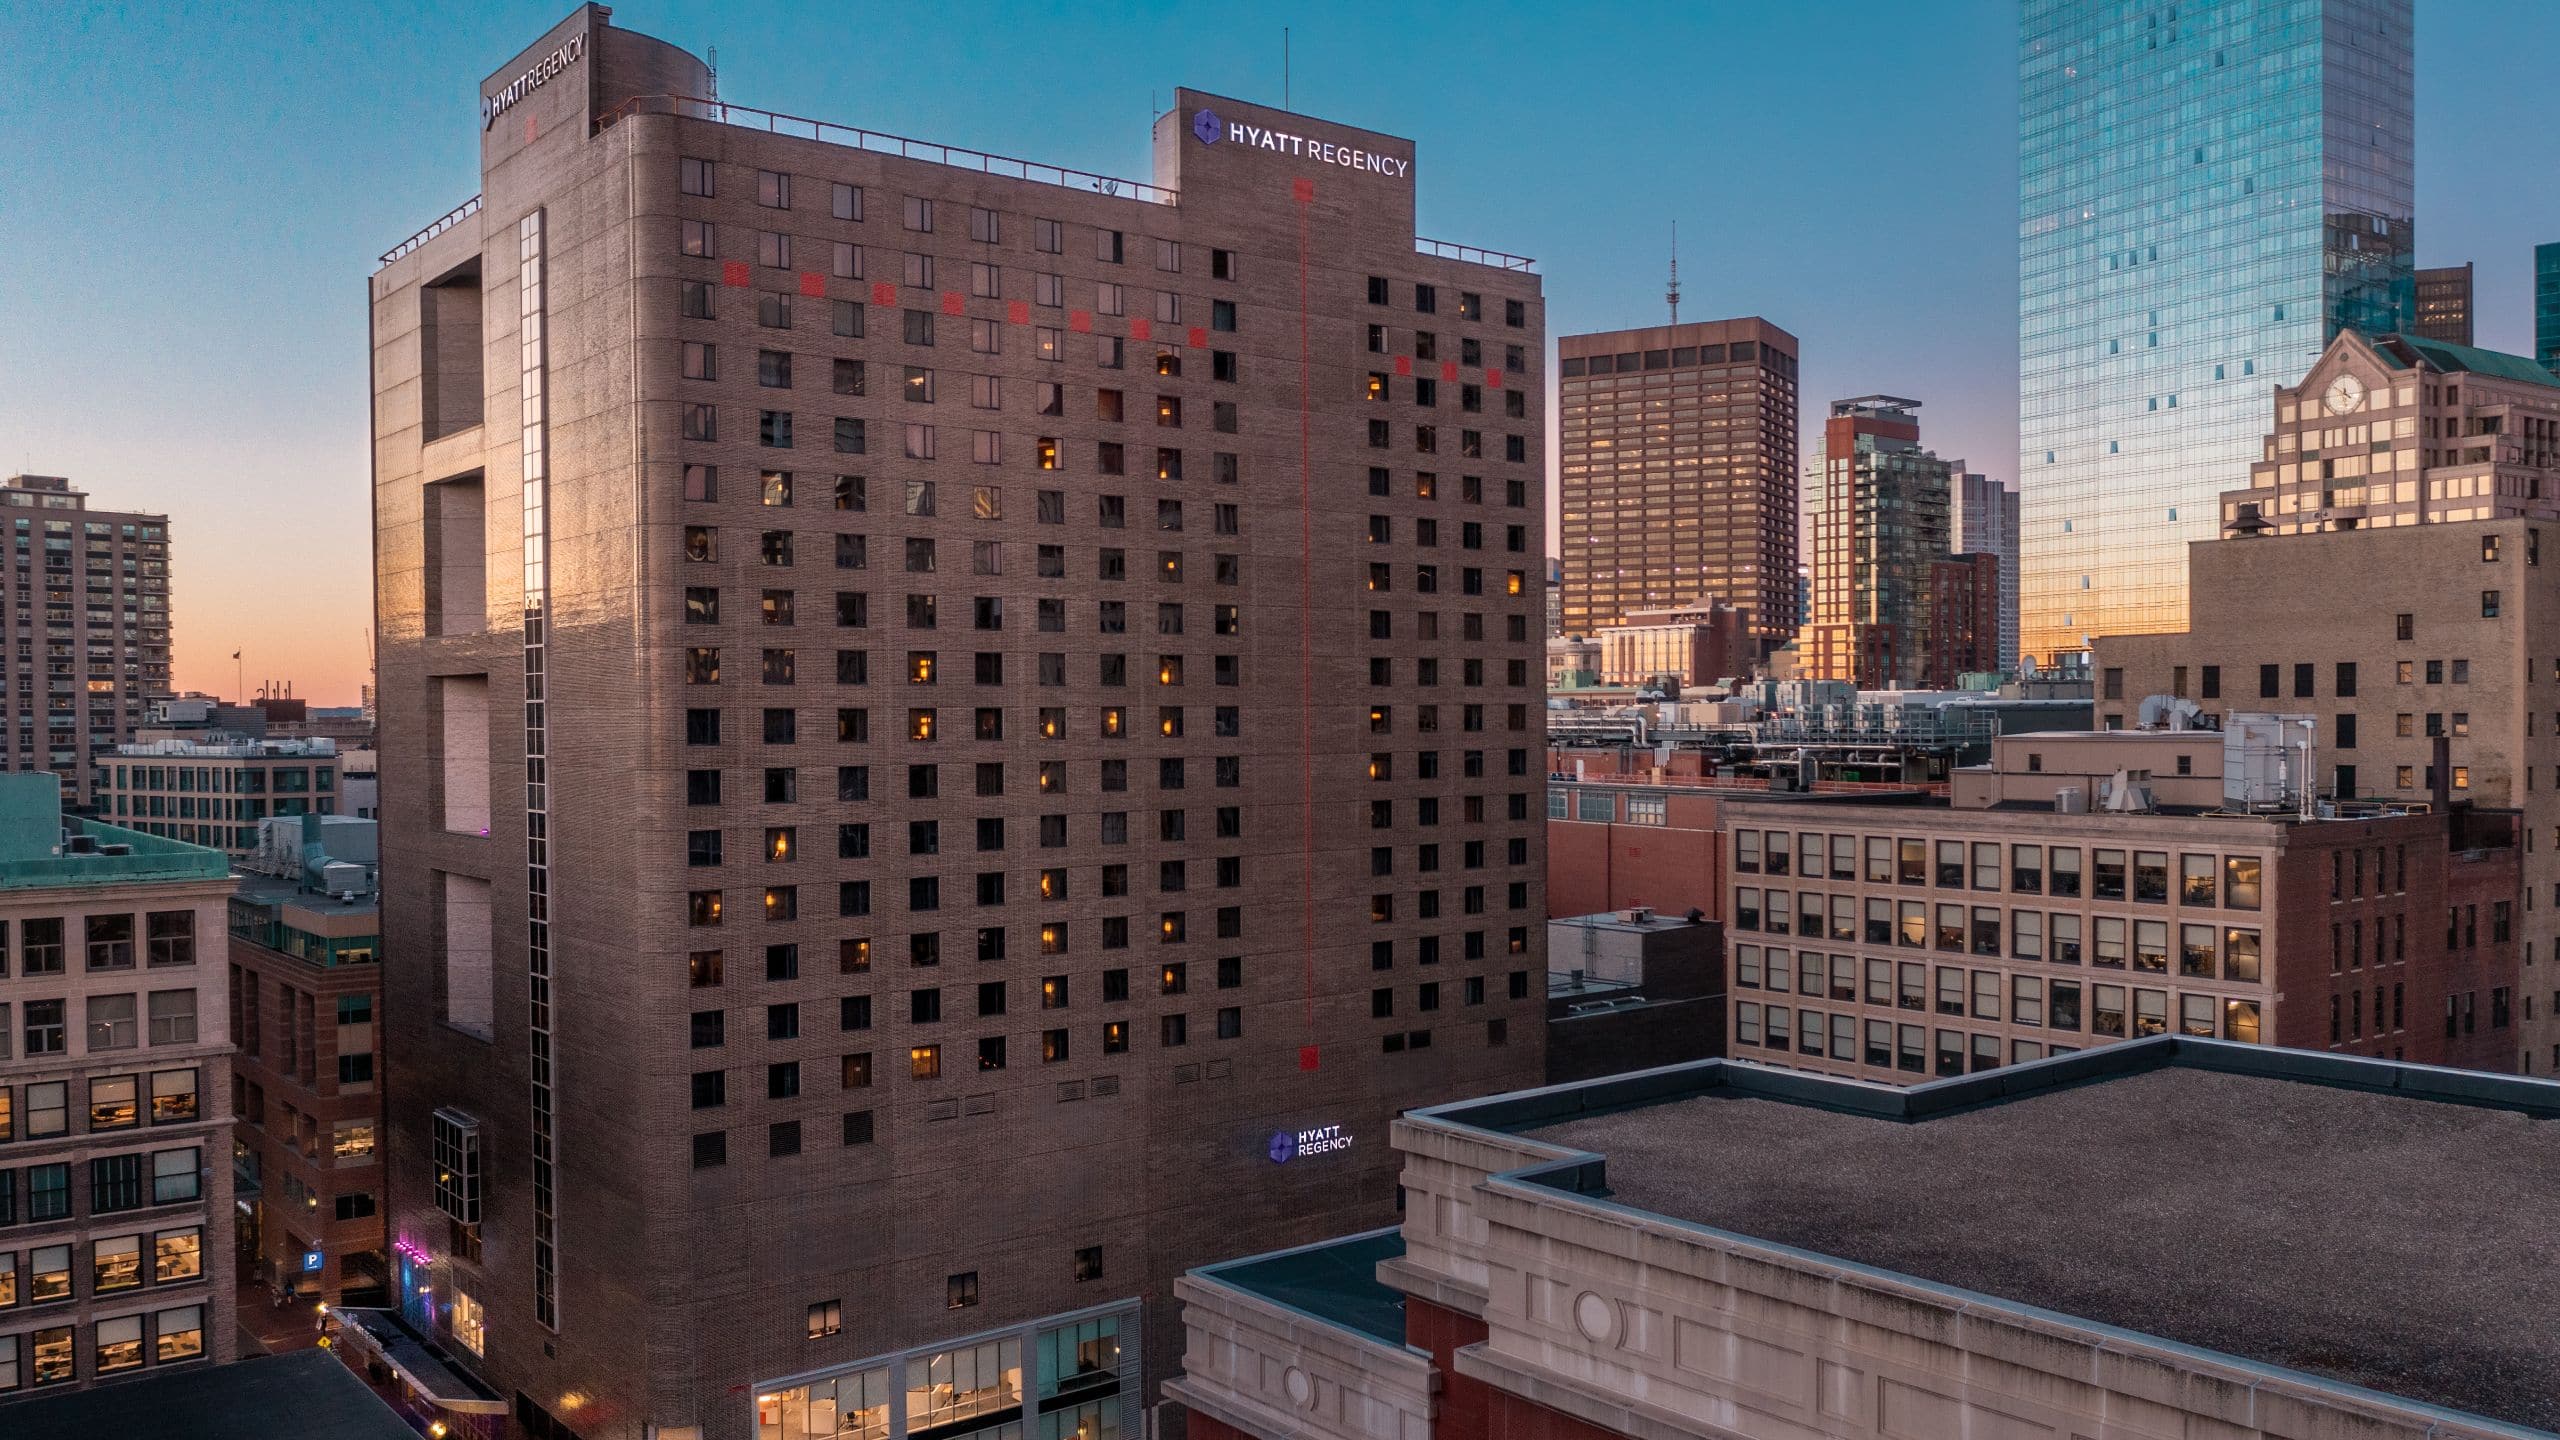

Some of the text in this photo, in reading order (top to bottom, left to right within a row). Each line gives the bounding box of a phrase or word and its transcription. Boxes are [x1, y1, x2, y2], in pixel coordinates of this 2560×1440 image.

[493, 32, 584, 117] HYATT REGENCY
[1229, 122, 1408, 178] HYATT REGENCY
[1298, 1125, 1340, 1143] HYATT
[1298, 1135, 1353, 1157] REGENCY
[308, 1254, 318, 1265] P
